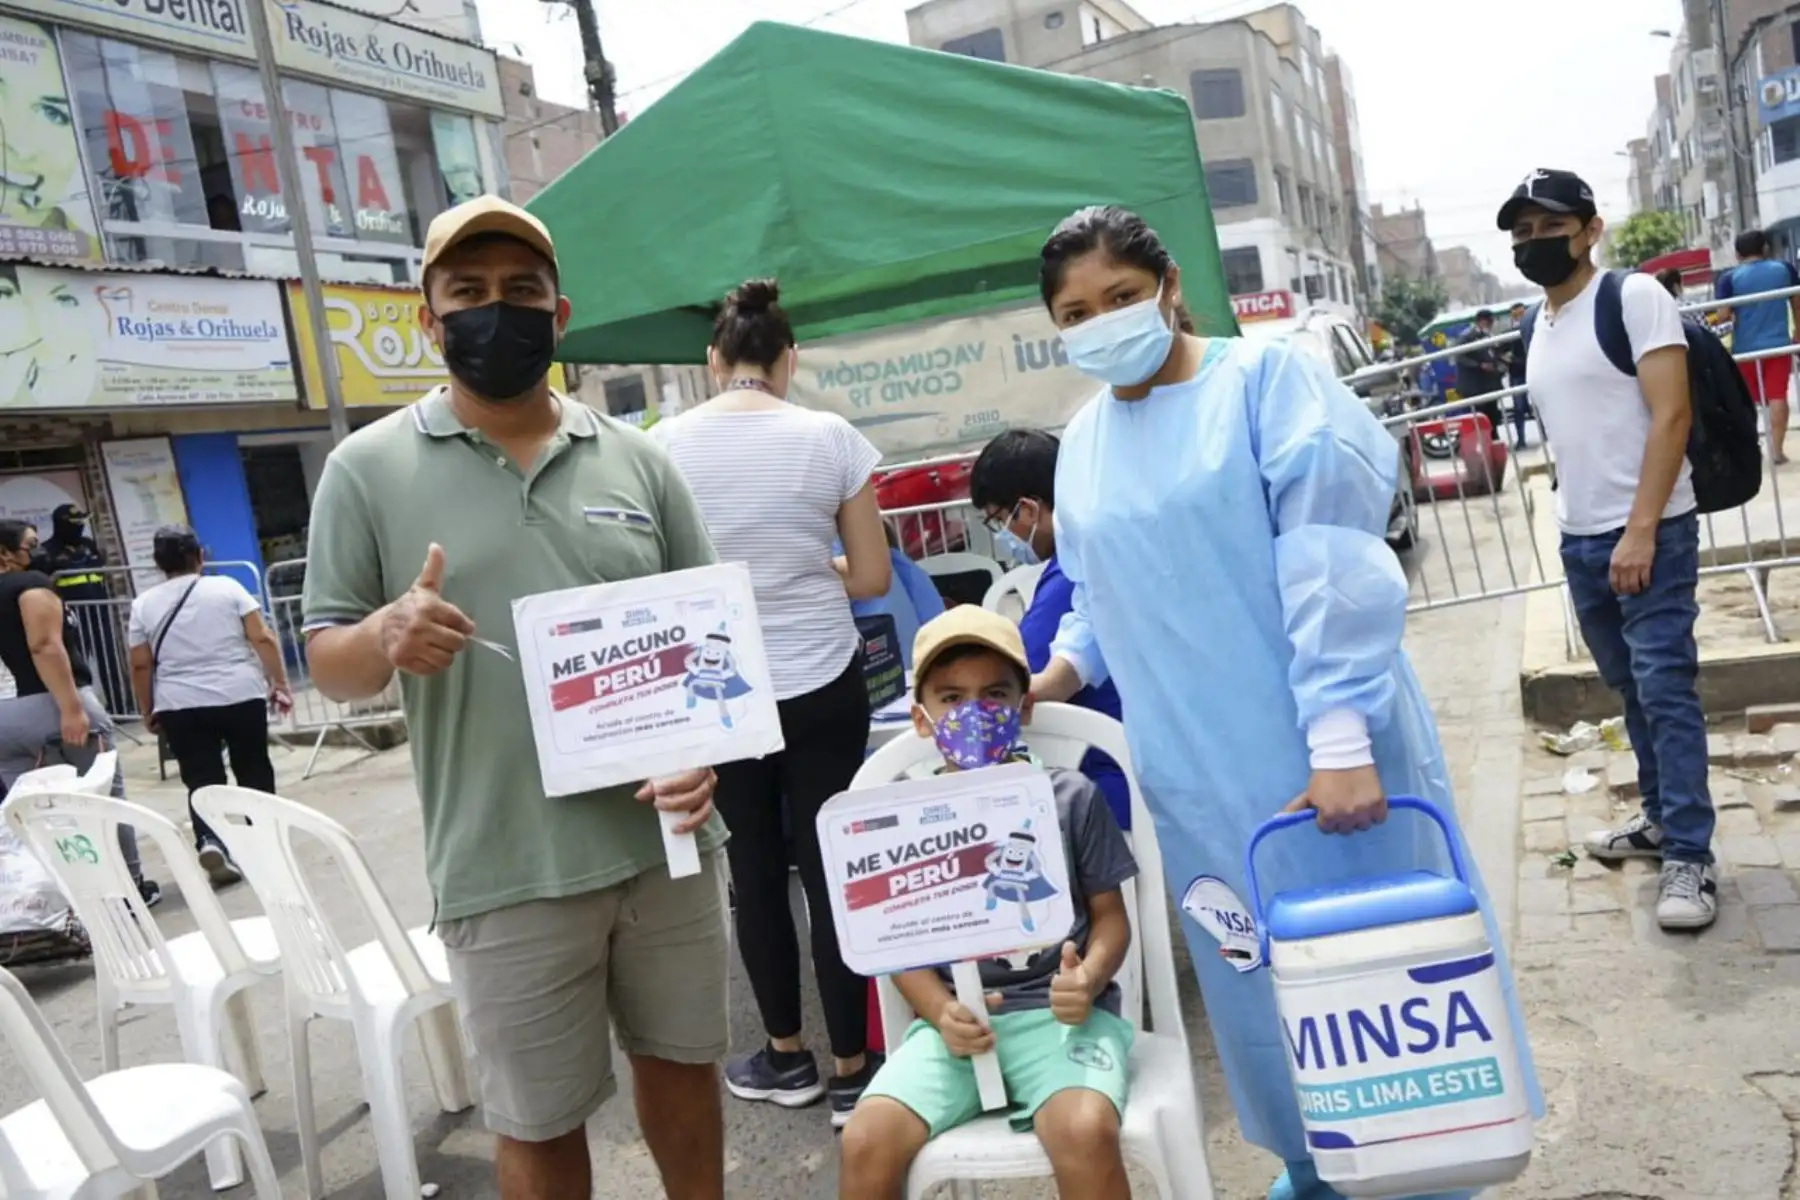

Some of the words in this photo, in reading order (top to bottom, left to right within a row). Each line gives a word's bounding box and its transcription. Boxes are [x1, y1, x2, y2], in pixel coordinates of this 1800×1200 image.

[286, 12, 358, 59] Rojas
[365, 34, 387, 65] &
[393, 41, 487, 90] Orihuela
[240, 100, 322, 131] CETRO
[241, 193, 287, 219] Roja
[117, 317, 175, 342] Rojas
[180, 320, 195, 336] &
[198, 319, 278, 338] Orihuela
[552, 655, 586, 679] ME
[591, 626, 686, 666] VACUNO
[593, 652, 662, 697] PERÚ
[846, 854, 881, 879] ME
[886, 823, 988, 866] VACUNO
[888, 852, 961, 897] PERÚ
[1283, 990, 1493, 1070] MINSA
[1356, 1077, 1423, 1110] LIMA
[1427, 1064, 1497, 1097] ESTE
